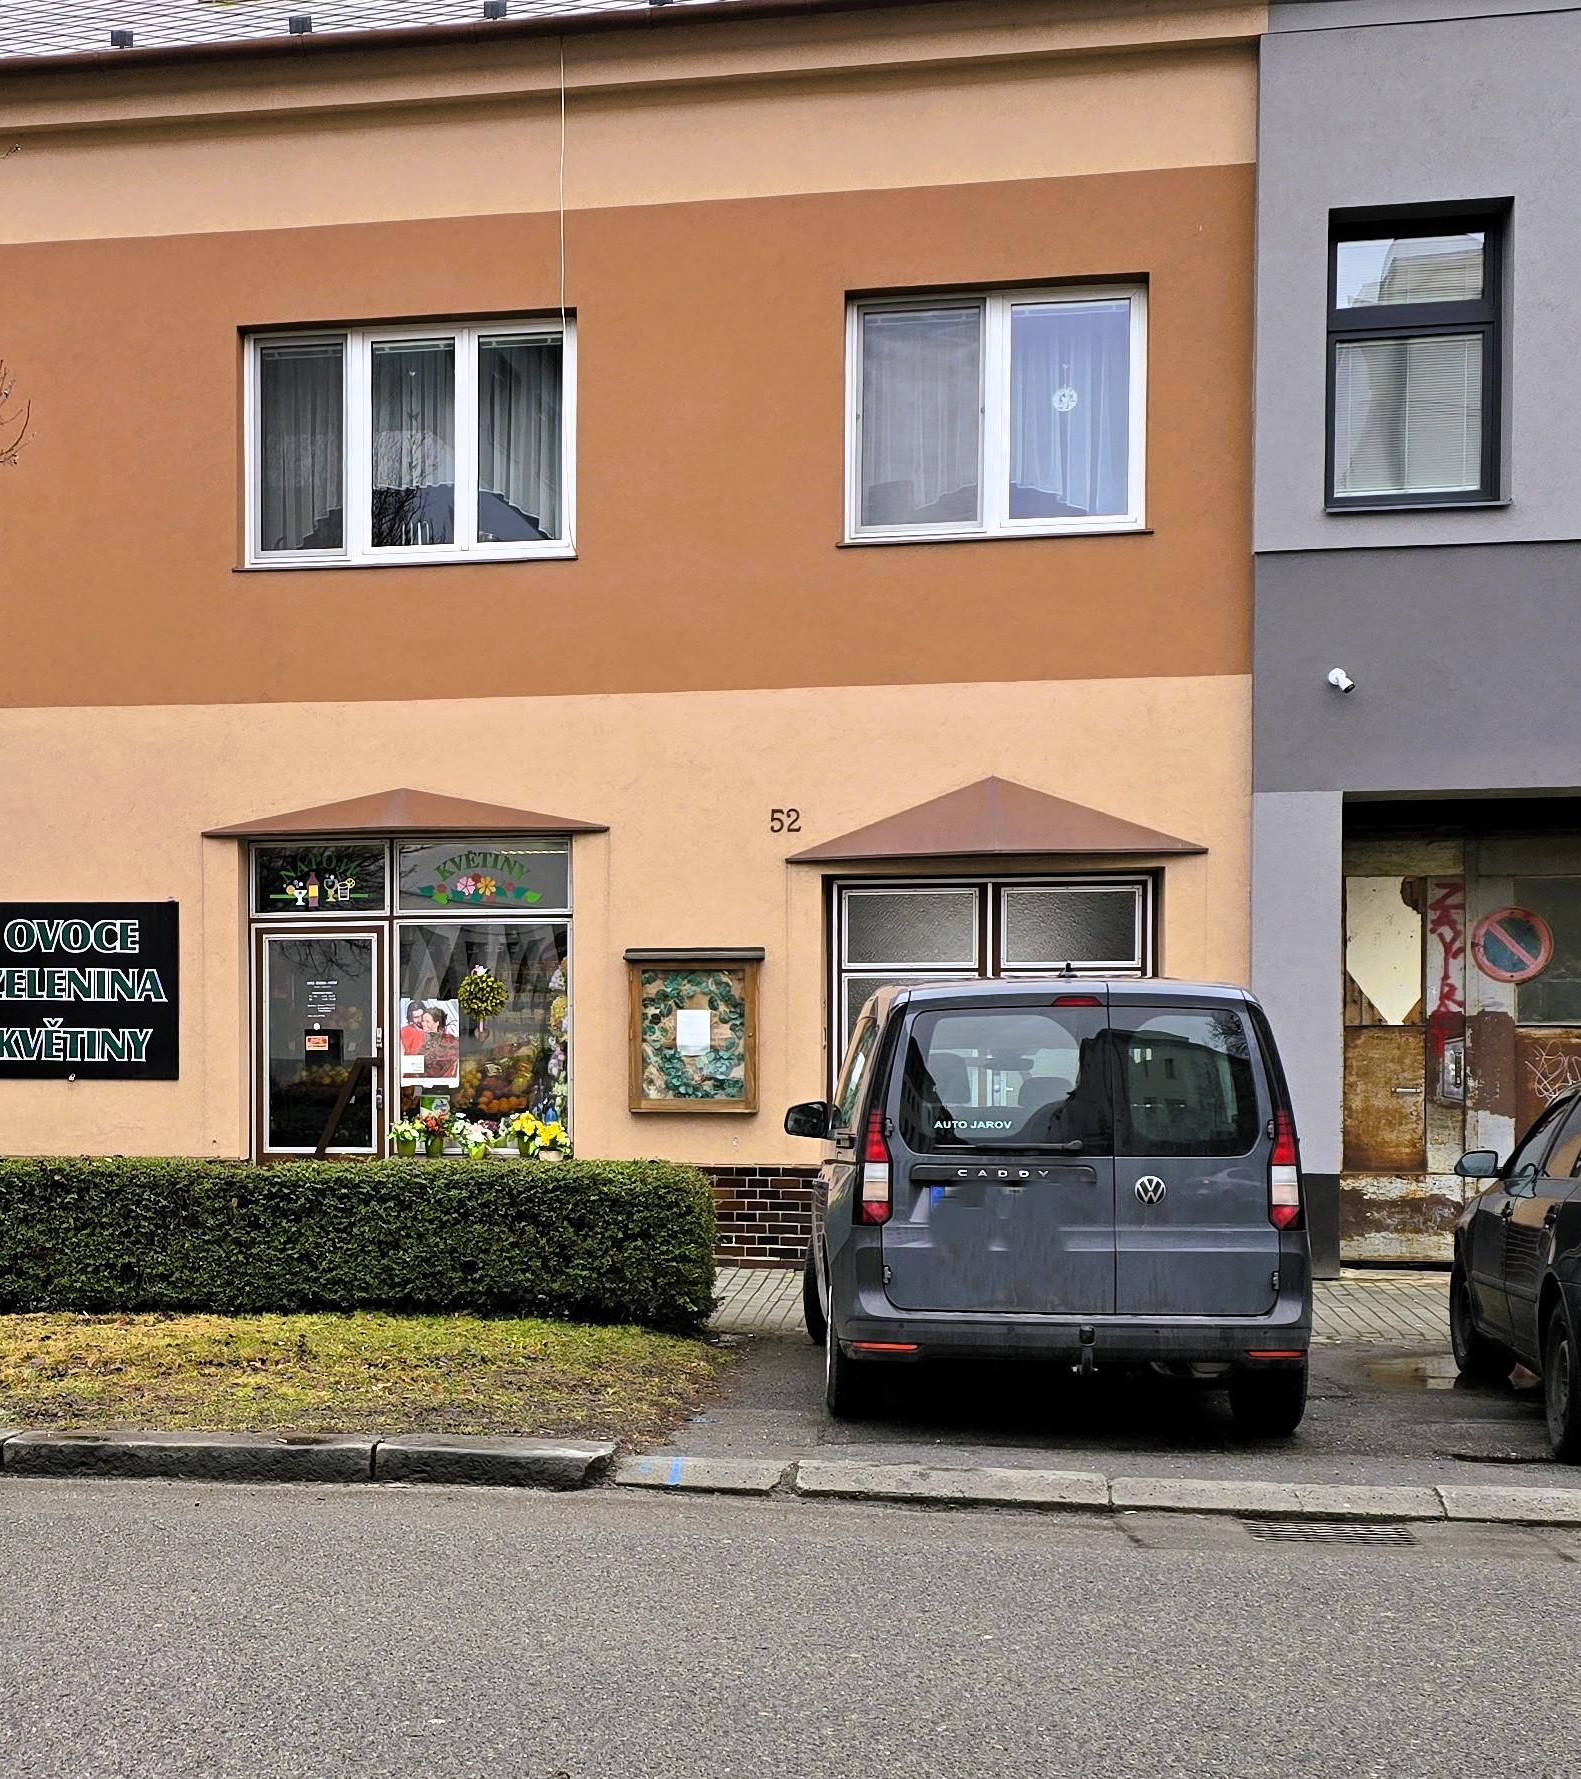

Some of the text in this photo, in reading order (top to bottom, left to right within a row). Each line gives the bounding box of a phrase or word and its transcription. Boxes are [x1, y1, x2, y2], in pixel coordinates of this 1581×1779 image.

[770, 808, 802, 833] 52
[4, 919, 139, 953] OVOCE
[933, 1120, 1013, 1129] AUTO JAROV
[957, 1168, 1049, 1178] CADDY
[1134, 1175, 1167, 1206] VW
